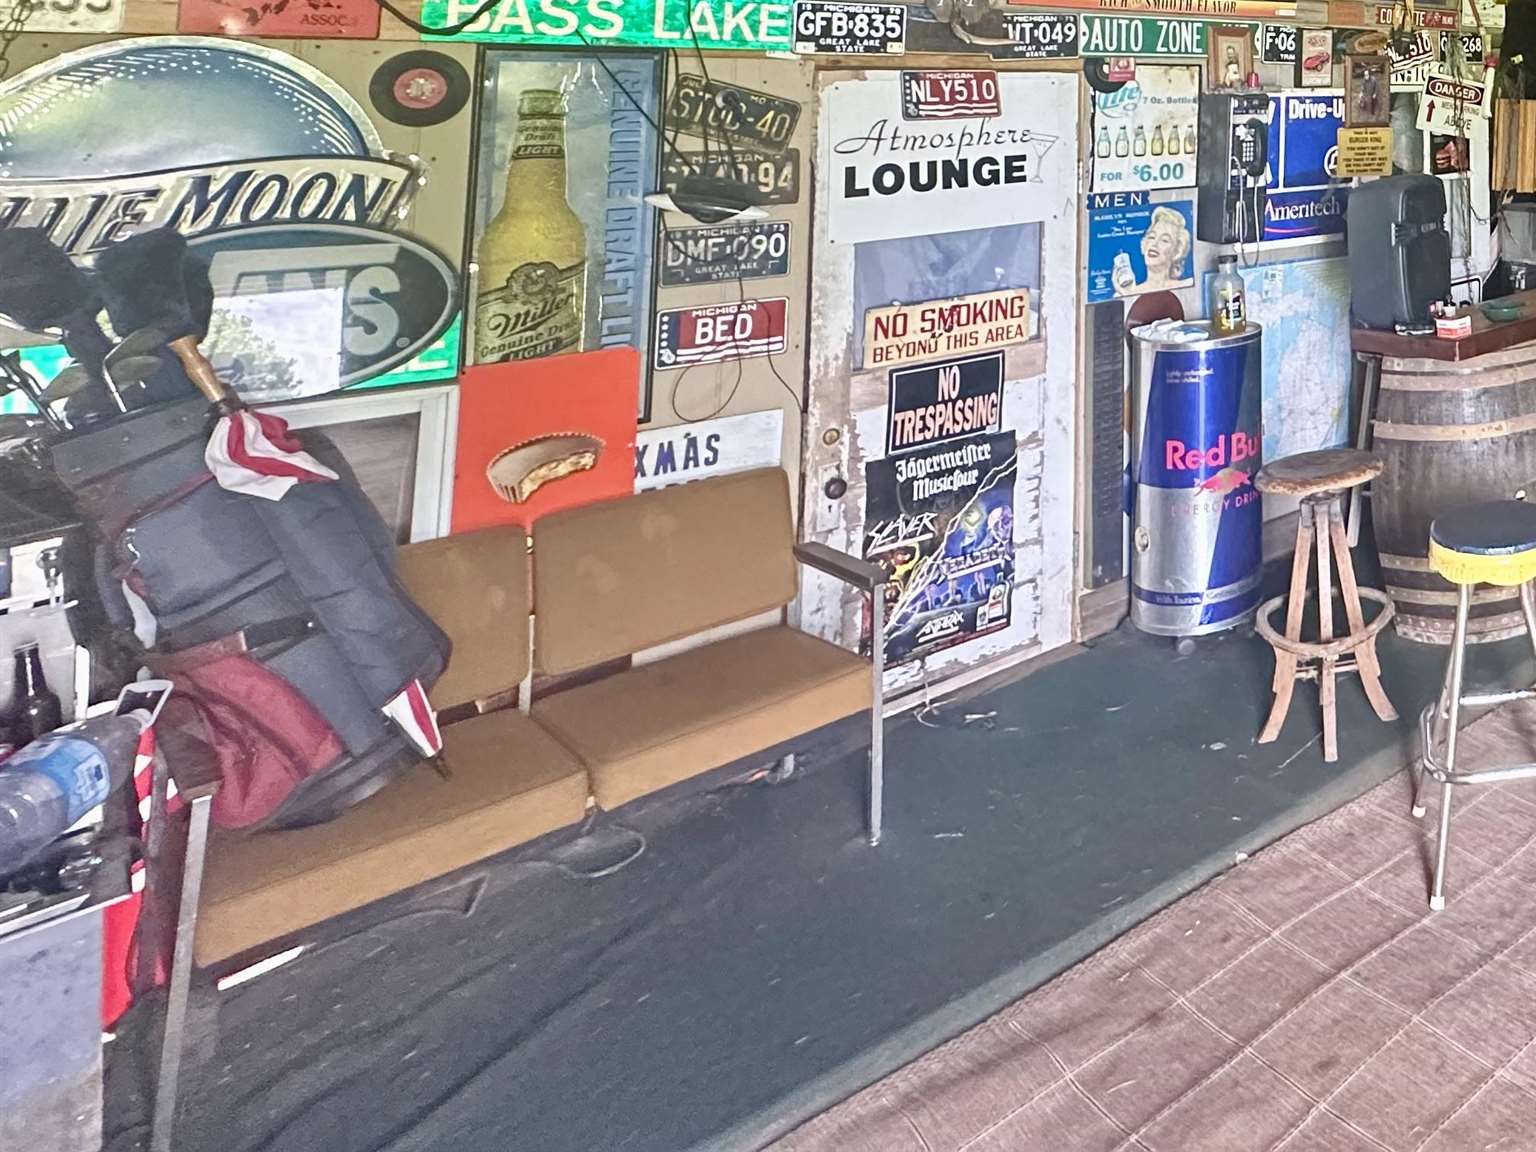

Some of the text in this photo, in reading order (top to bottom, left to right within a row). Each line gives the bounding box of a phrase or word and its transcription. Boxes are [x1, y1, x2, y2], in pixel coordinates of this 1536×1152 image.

[823, 4, 880, 14] MICHIGAN
[1197, 0, 1238, 15] FLAVOR
[819, 38, 851, 46] GREAT
[1090, 18, 1203, 54] AUTO ZONE
[910, 79, 997, 103] NLY510
[926, 72, 975, 80] MICHIGAN
[1435, 83, 1475, 100] DANGER
[517, 145, 561, 156] LIGHT
[833, 118, 1031, 158] Atmosphere
[844, 154, 1027, 199] LOUNGE
[1101, 163, 1184, 182] FOR $6.00
[167, 169, 396, 229] MOON
[1095, 193, 1142, 208] MEN
[1265, 197, 1340, 222] Ameritech
[602, 207, 637, 306] DRAFT
[488, 294, 575, 338] Miller
[692, 304, 757, 317] MICHIGAN
[874, 296, 1025, 341] NO SMOKING
[481, 329, 545, 359] Genuine
[695, 314, 752, 345] BED
[872, 324, 1025, 364] BEYOND THIS AREA
[938, 365, 961, 402] NO
[894, 392, 998, 446] TRESPASSING
[895, 443, 991, 483] Jägermeister
[1166, 434, 1225, 470] Red
